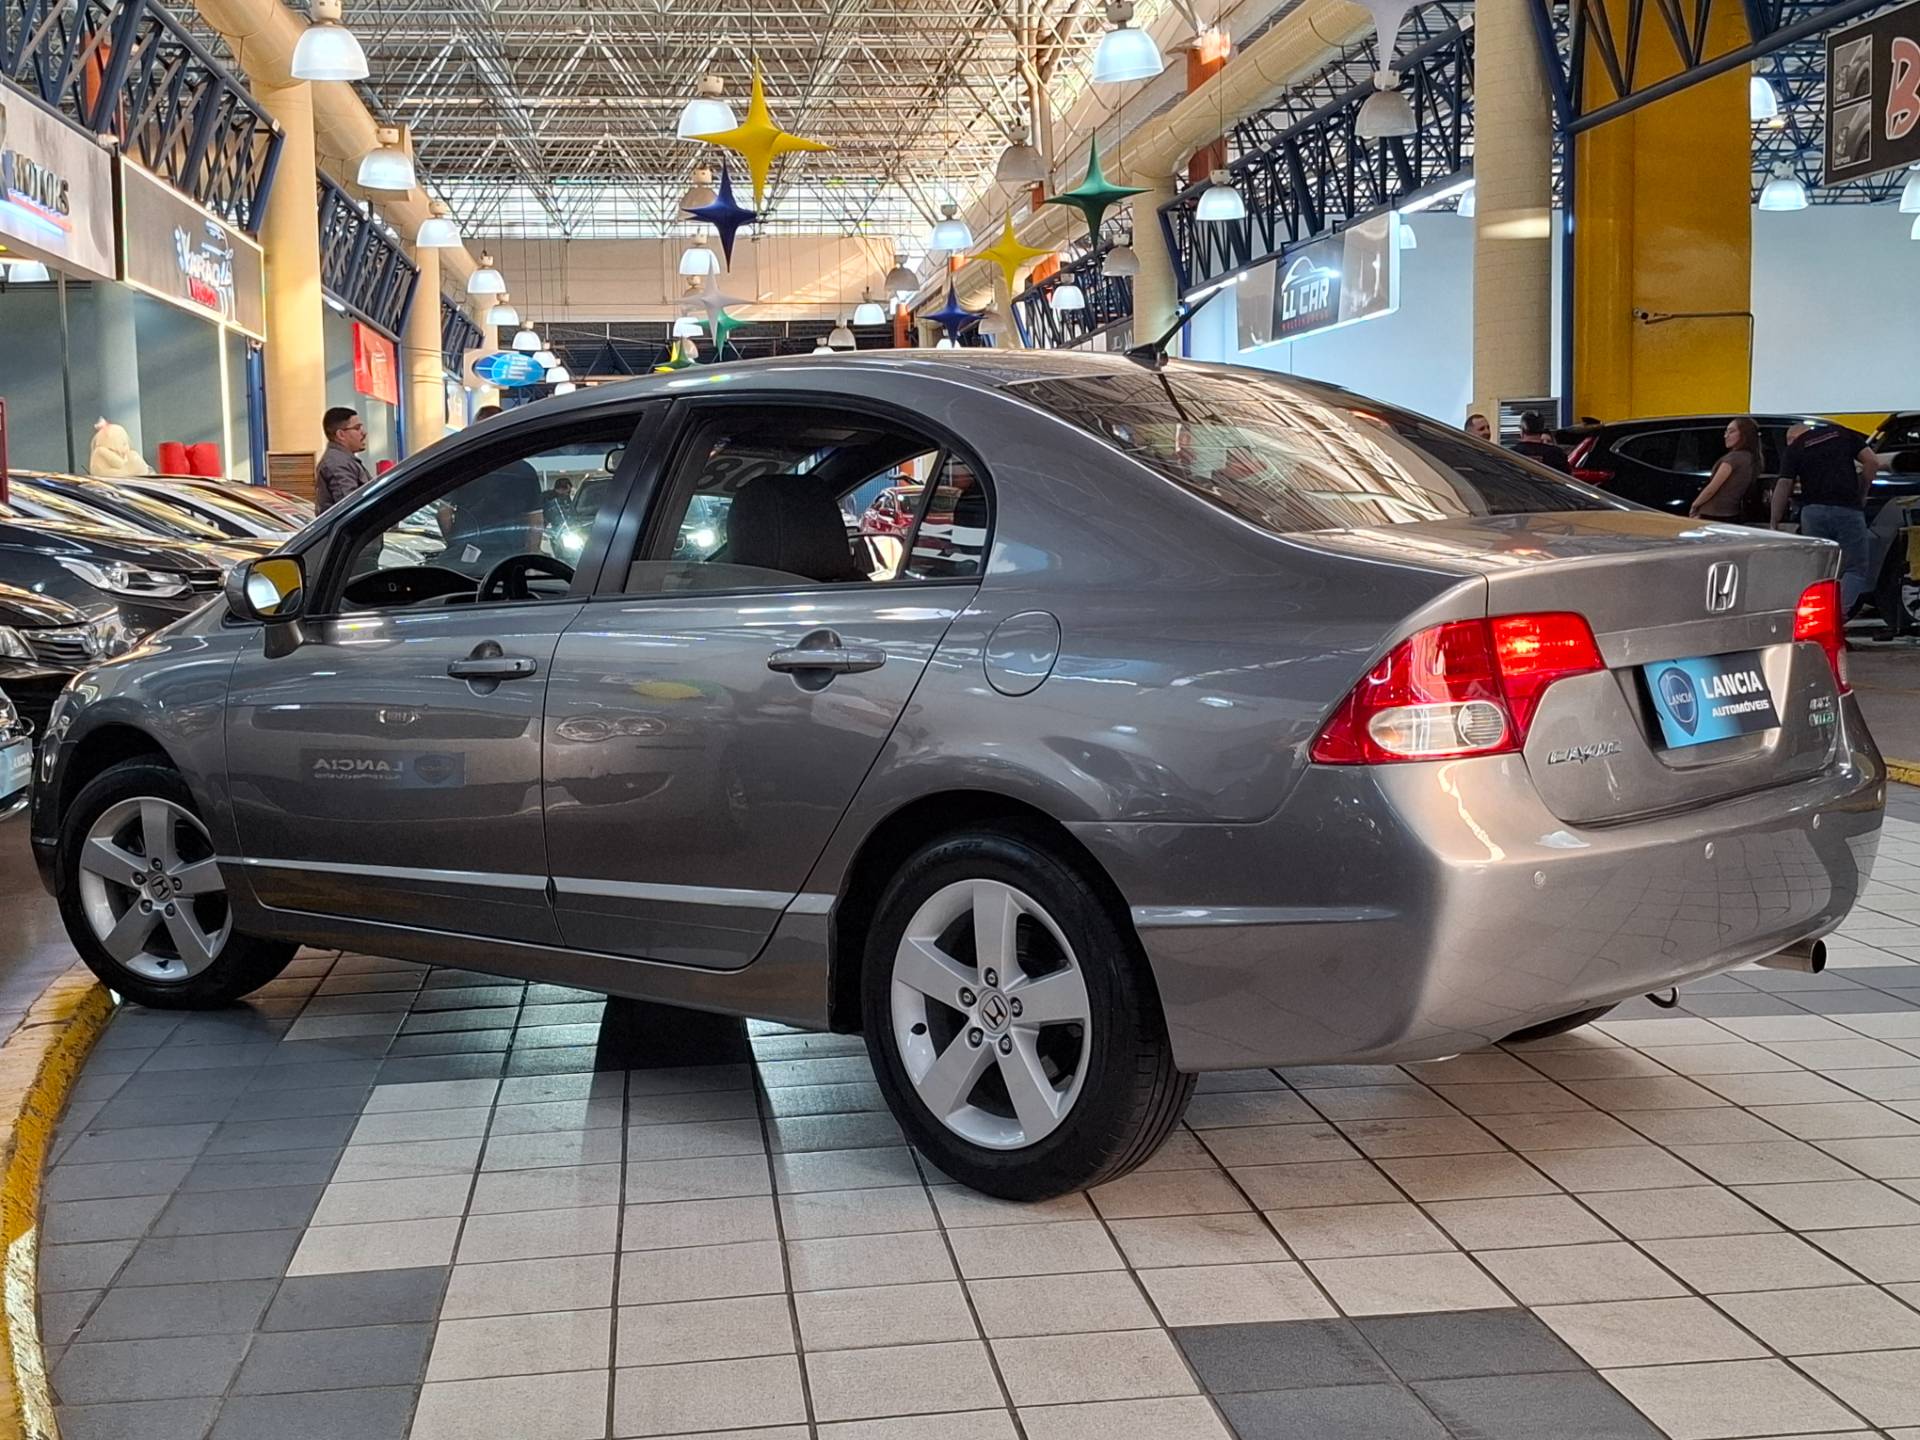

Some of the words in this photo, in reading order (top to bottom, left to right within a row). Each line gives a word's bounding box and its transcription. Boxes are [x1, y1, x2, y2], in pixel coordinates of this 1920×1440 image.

[1282, 289, 1297, 321] LL
[1299, 277, 1330, 315] CAR
[1700, 670, 1764, 699] LANCIA
[1667, 692, 1693, 706] LANCIA
[1712, 699, 1770, 717] AUTOMÓVEIS
